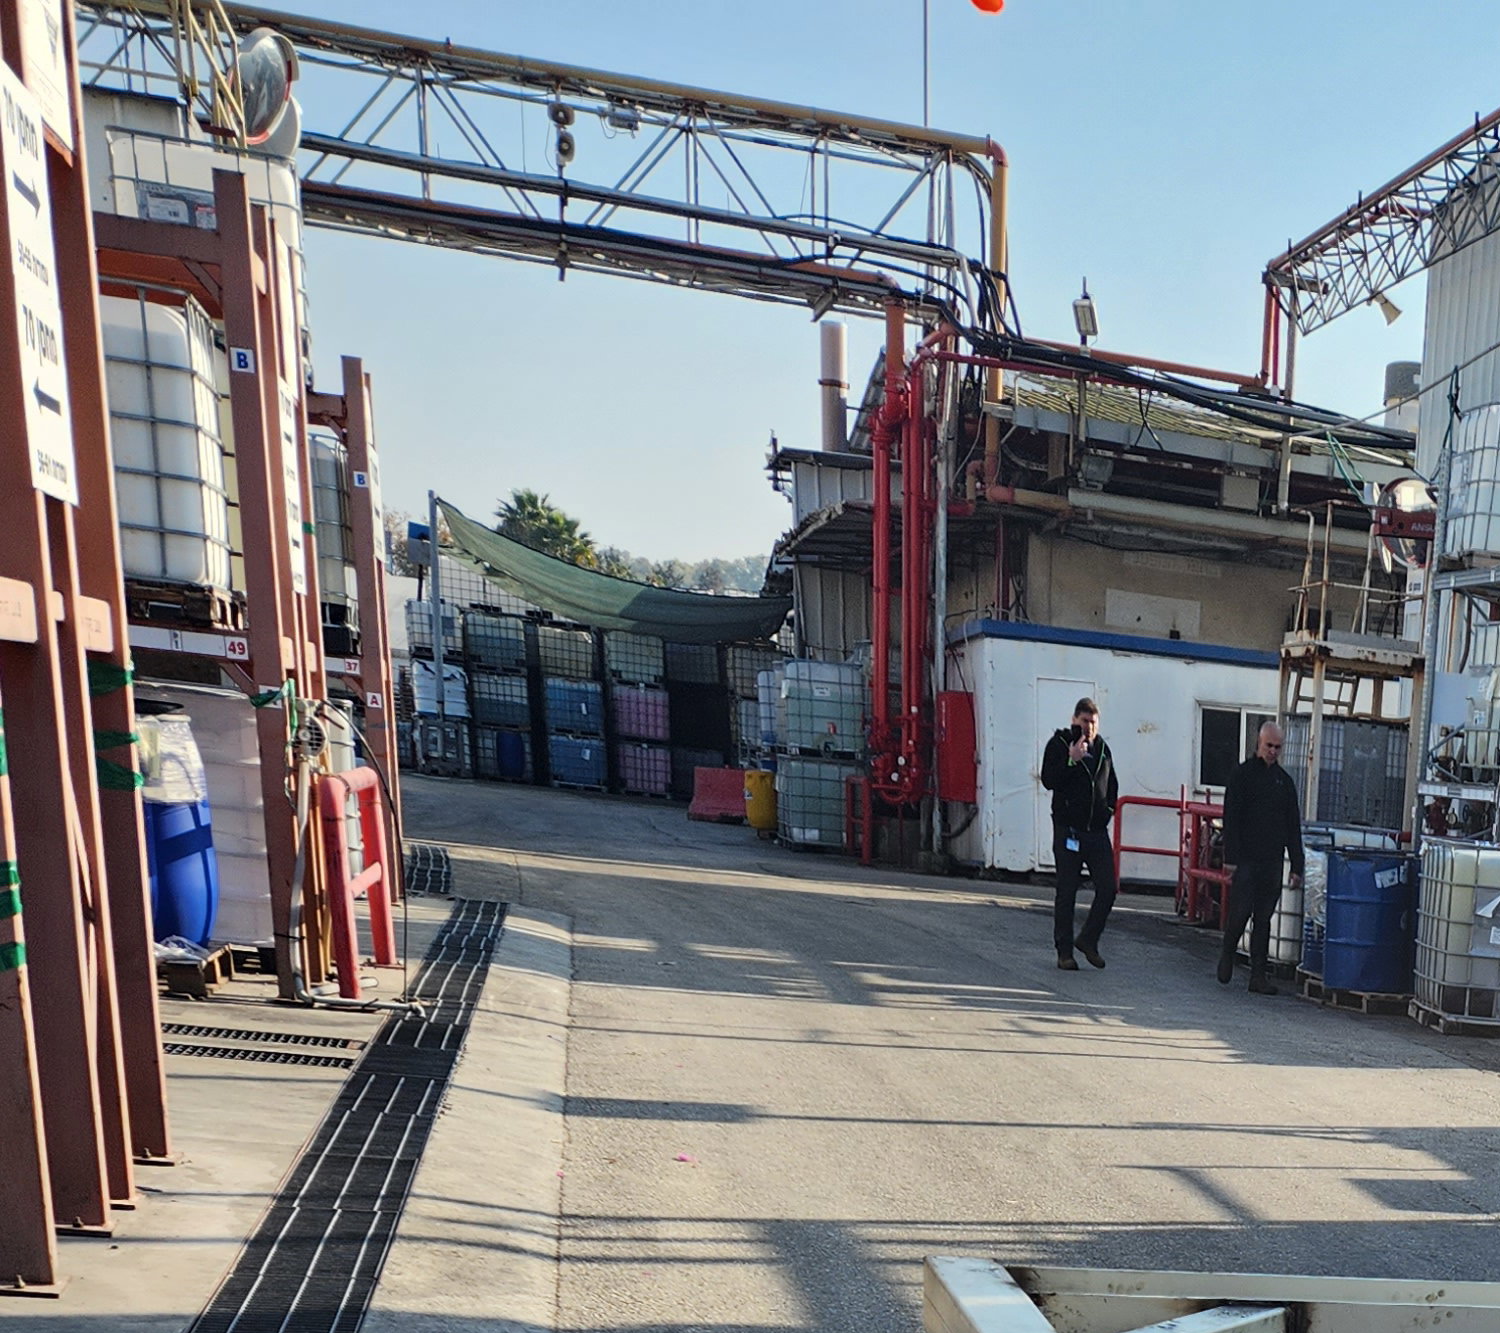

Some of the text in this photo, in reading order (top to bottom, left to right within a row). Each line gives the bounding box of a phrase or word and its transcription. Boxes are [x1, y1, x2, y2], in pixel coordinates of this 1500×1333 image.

[22, 303, 35, 351] 70
[236, 351, 249, 369] B
[357, 473, 366, 486] B
[227, 640, 246, 656] 49
[345, 661, 358, 672] 37
[370, 694, 380, 706] A
